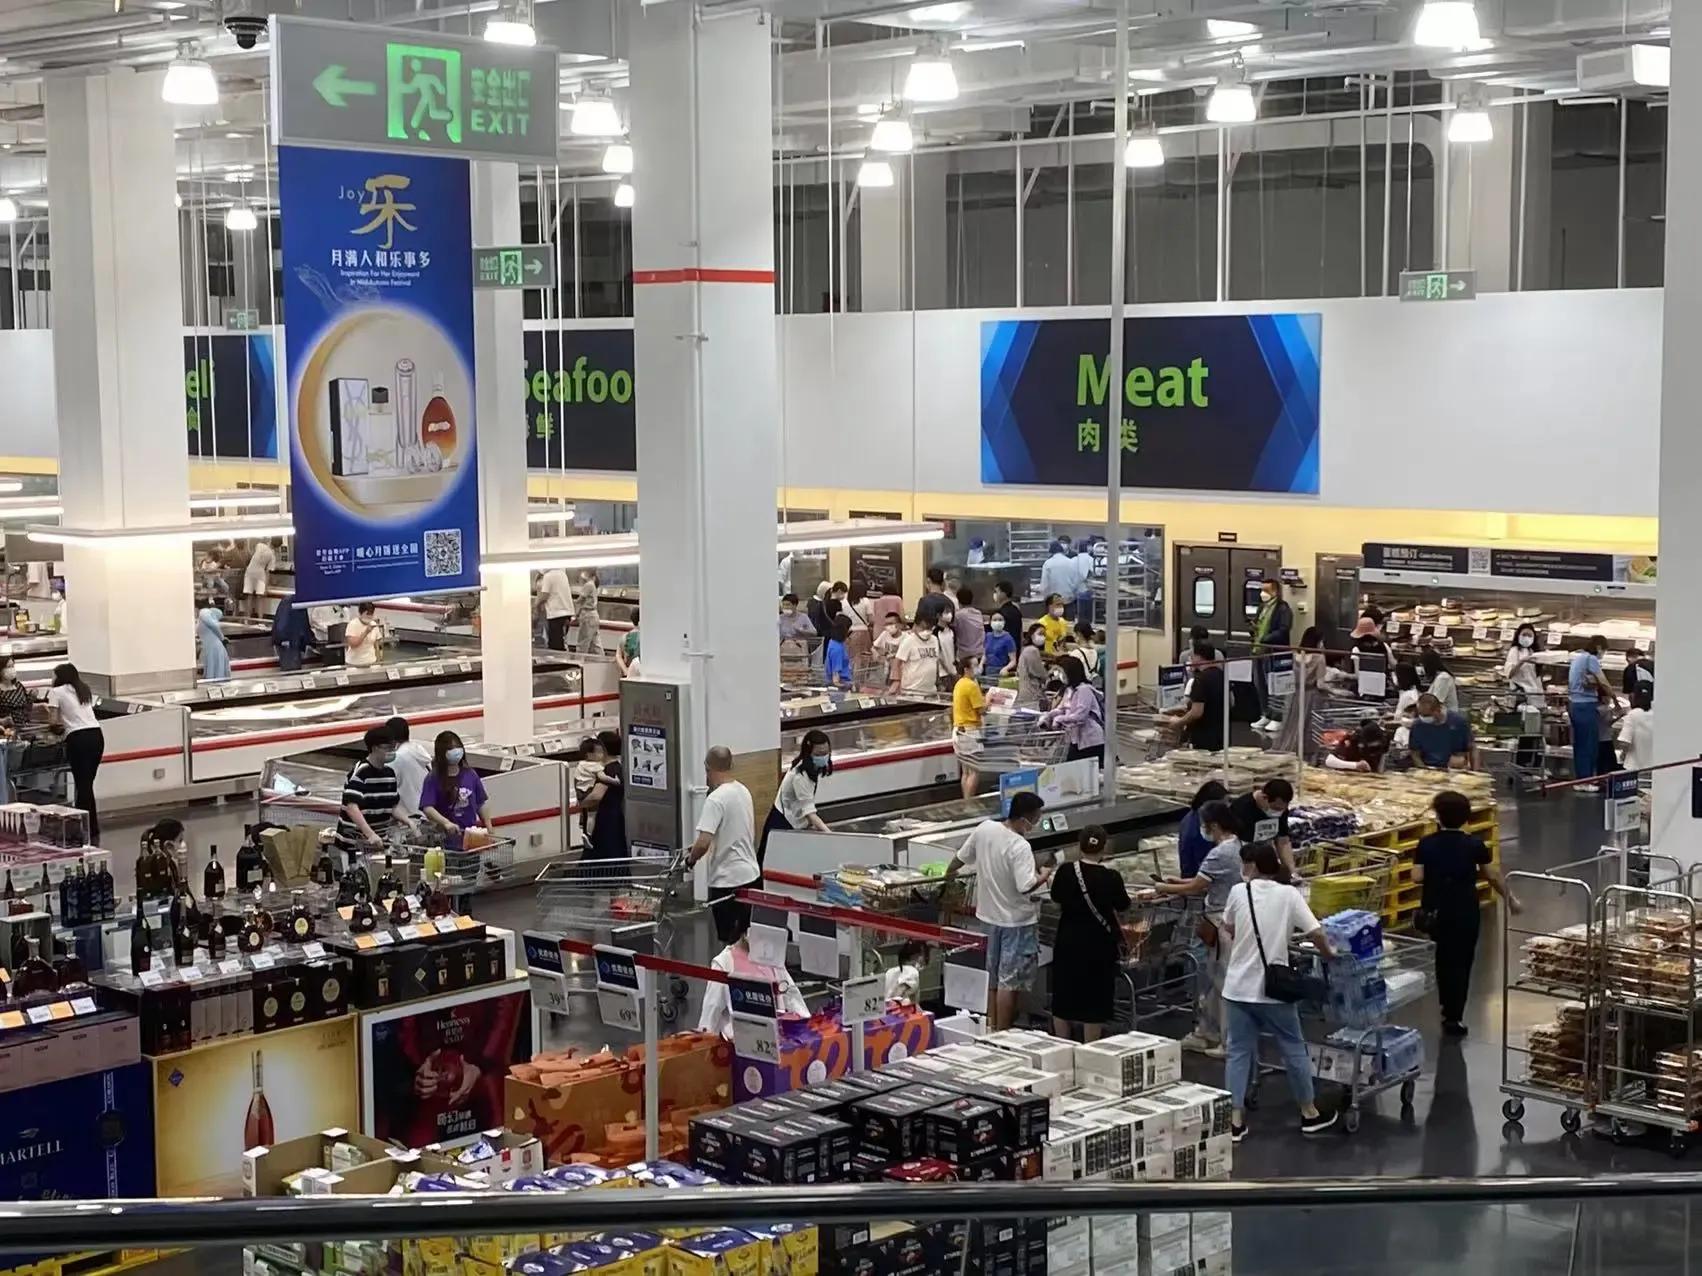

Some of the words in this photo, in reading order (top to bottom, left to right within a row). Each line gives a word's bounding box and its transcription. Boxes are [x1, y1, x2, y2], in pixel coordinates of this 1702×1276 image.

[471, 109, 530, 136] EXIT
[338, 185, 366, 204] Joy
[350, 174, 418, 249] 乐
[331, 248, 431, 268] 月满人和乐事多
[480, 272, 498, 281] EXIT
[185, 359, 216, 399] eli
[525, 356, 632, 404] eafoo
[1076, 354, 1209, 408] Meat
[1077, 418, 1139, 453] 肉类
[436, 1016, 471, 1031] Hennessy
